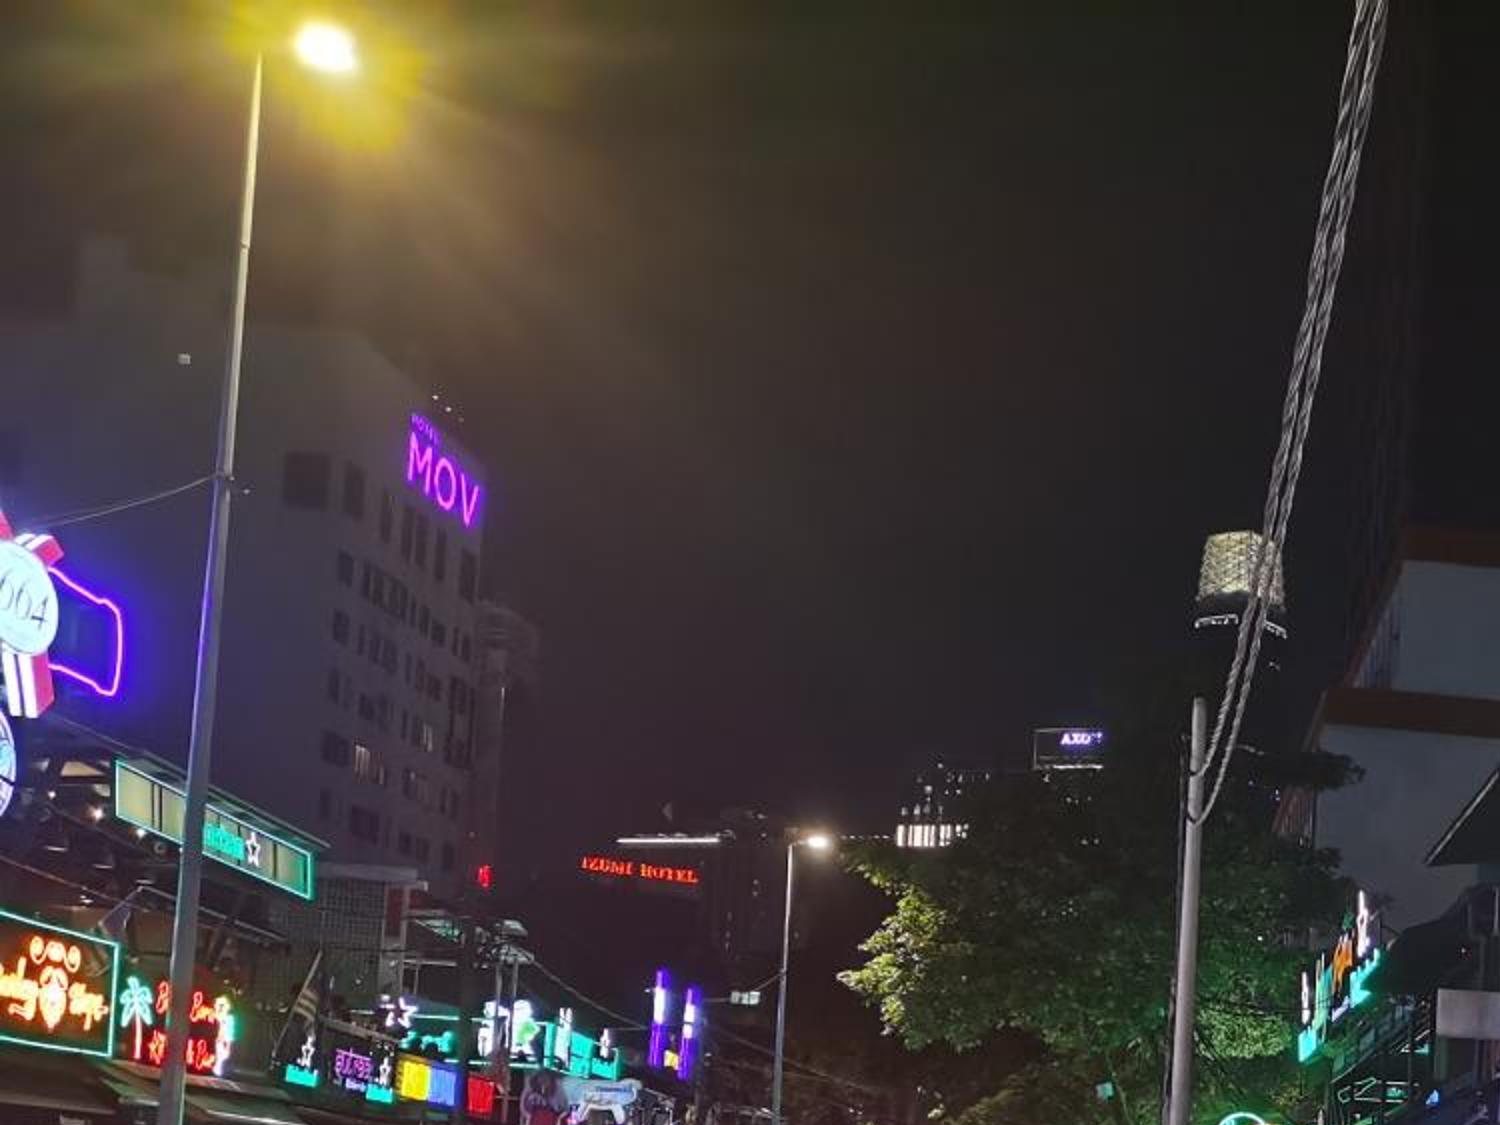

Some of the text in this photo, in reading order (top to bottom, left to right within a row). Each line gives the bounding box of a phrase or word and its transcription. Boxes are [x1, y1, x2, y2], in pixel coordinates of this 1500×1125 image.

[407, 431, 480, 526] MOV
[581, 856, 699, 884] IZUMI HOTEL
